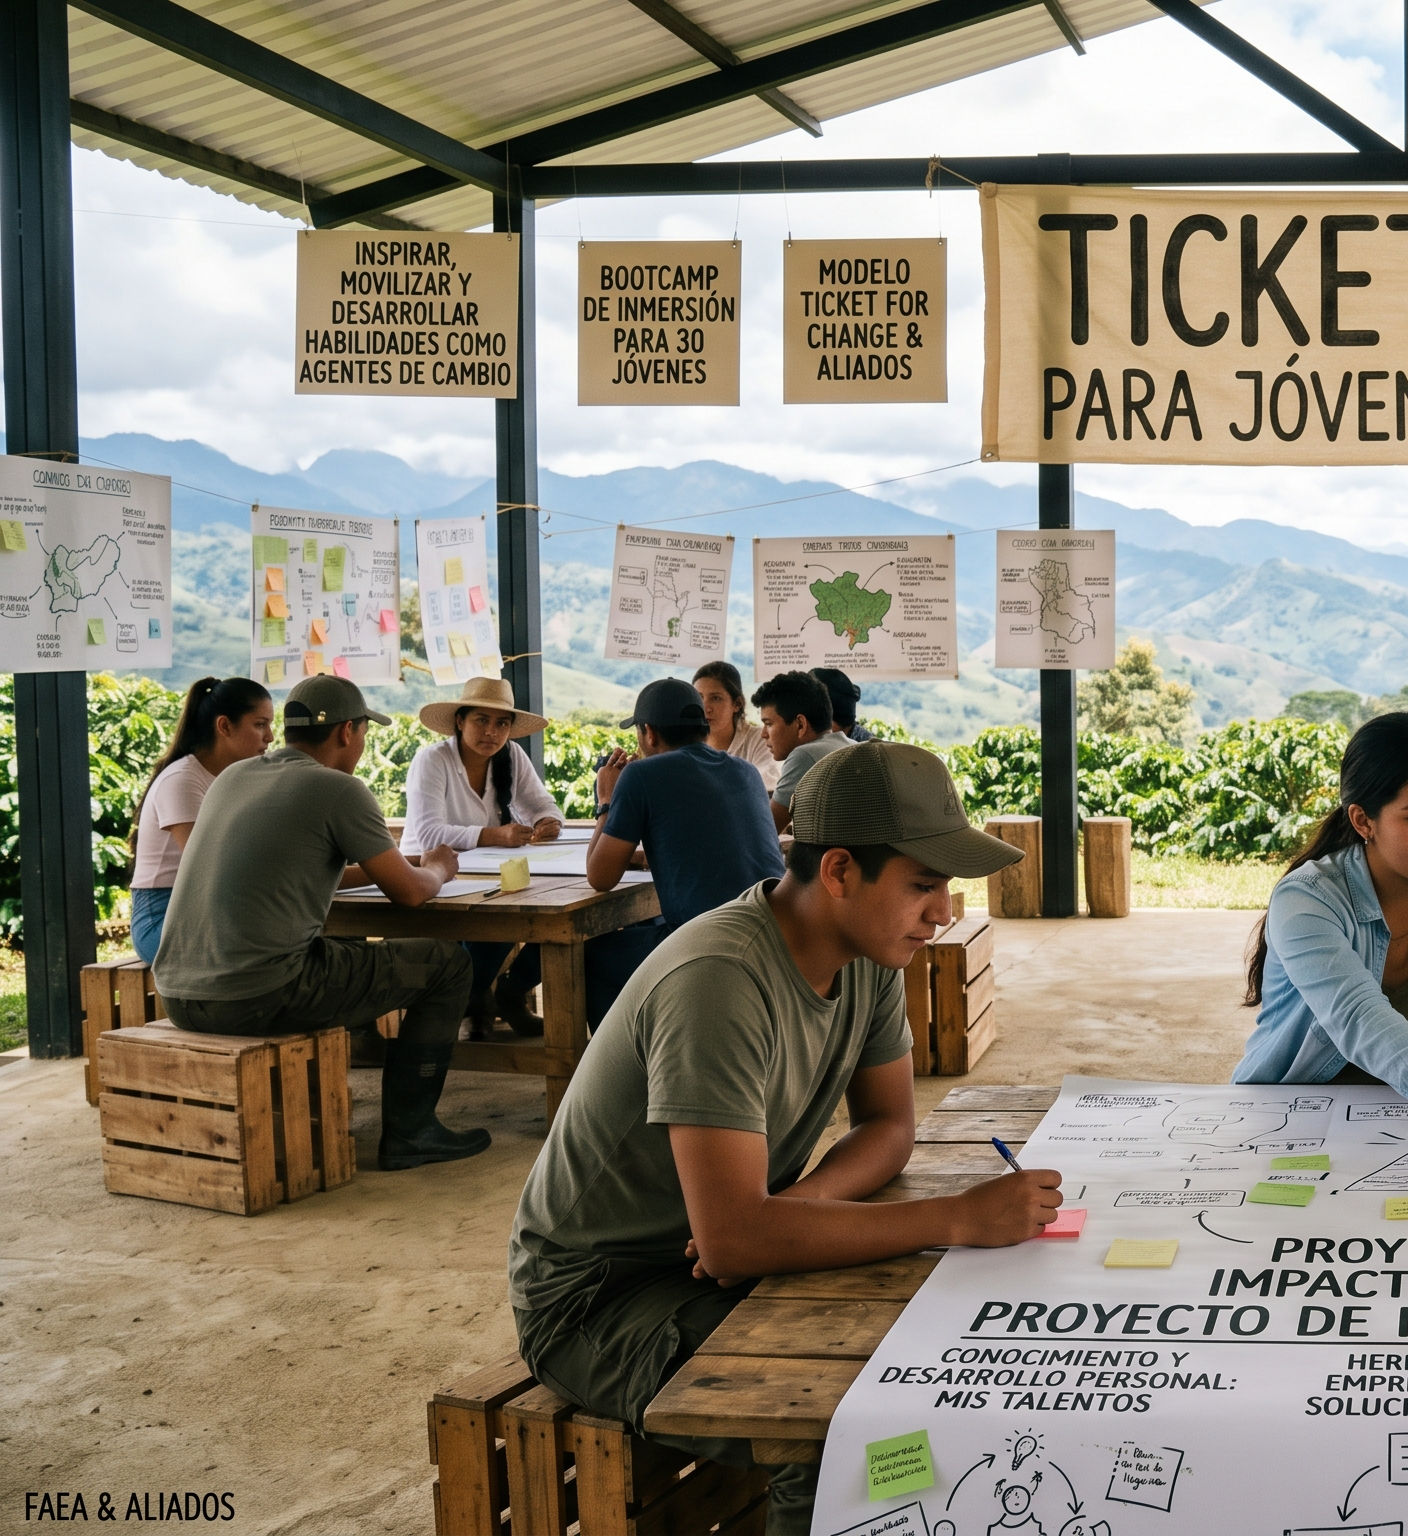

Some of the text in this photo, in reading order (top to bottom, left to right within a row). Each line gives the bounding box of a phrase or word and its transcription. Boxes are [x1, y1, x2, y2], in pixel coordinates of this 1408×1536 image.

[355, 241, 457, 272] INSPIRAR,
[340, 270, 473, 297] MOVILIZAR Y
[600, 264, 719, 292] BOOTCAMP
[819, 258, 911, 286] MODELO
[332, 300, 479, 327] DESARROLLAR
[583, 289, 735, 323] DE INMERSIÓN
[799, 290, 929, 318] TICKET FOR
[305, 329, 507, 357] HABILIDADES COMO
[613, 327, 705, 354] PARA 30
[807, 321, 924, 350] CHANGE &
[299, 359, 511, 387] AGENTES DE CAMBIO
[611, 352, 707, 385] JÓVENES
[816, 353, 913, 381] ALIADOS
[1043, 366, 1203, 442] PARA
[969, 1301, 1270, 1336] PROYECTO
[1296, 1305, 1372, 1337] DE
[941, 1347, 1190, 1368] CONOCIMIENTO Y
[878, 1366, 1237, 1390] DESARROLLO PERSONAL:
[933, 1390, 1152, 1413] MIS TALENTOS
